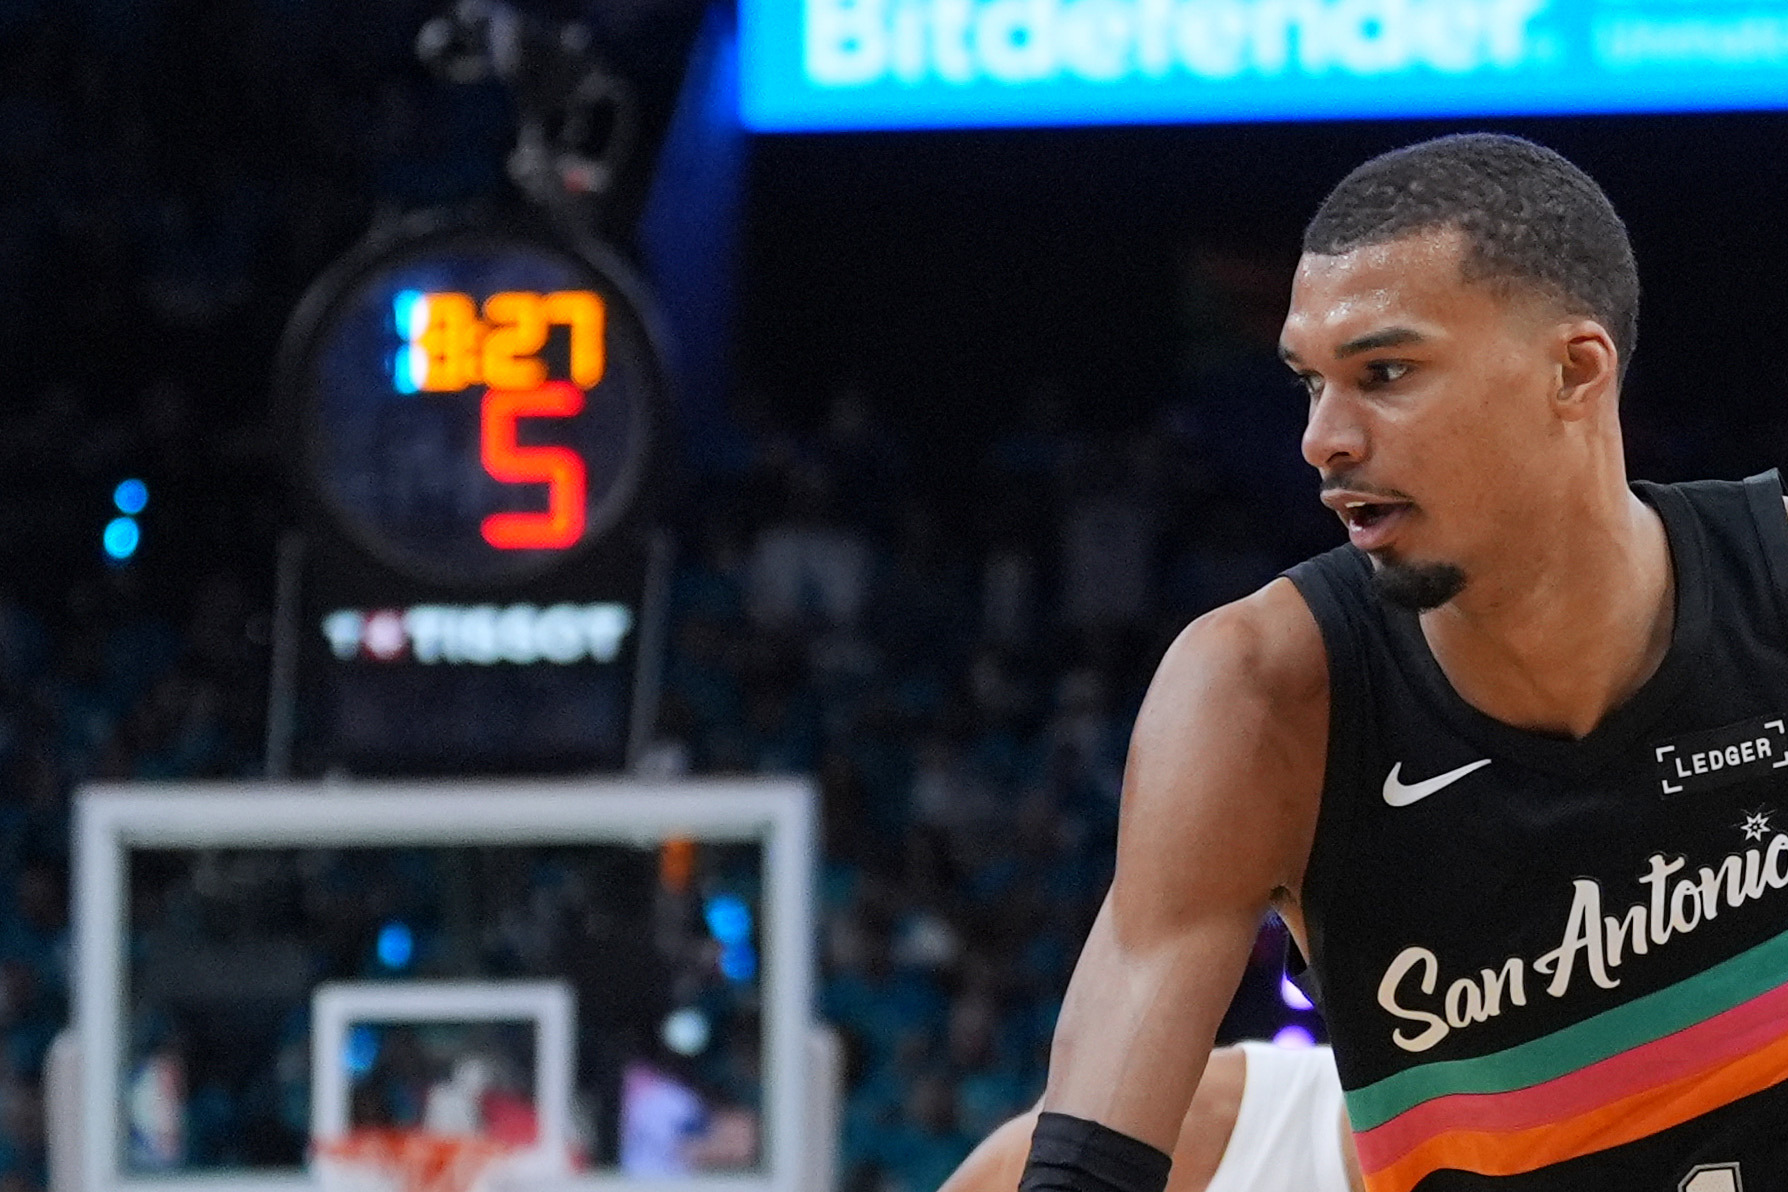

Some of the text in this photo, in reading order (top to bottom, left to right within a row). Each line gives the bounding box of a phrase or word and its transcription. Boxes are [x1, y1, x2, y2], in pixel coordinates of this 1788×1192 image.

[480, 380, 588, 549] 5
[1675, 737, 1772, 778] LEDGER
[1377, 946, 1527, 1053] San
